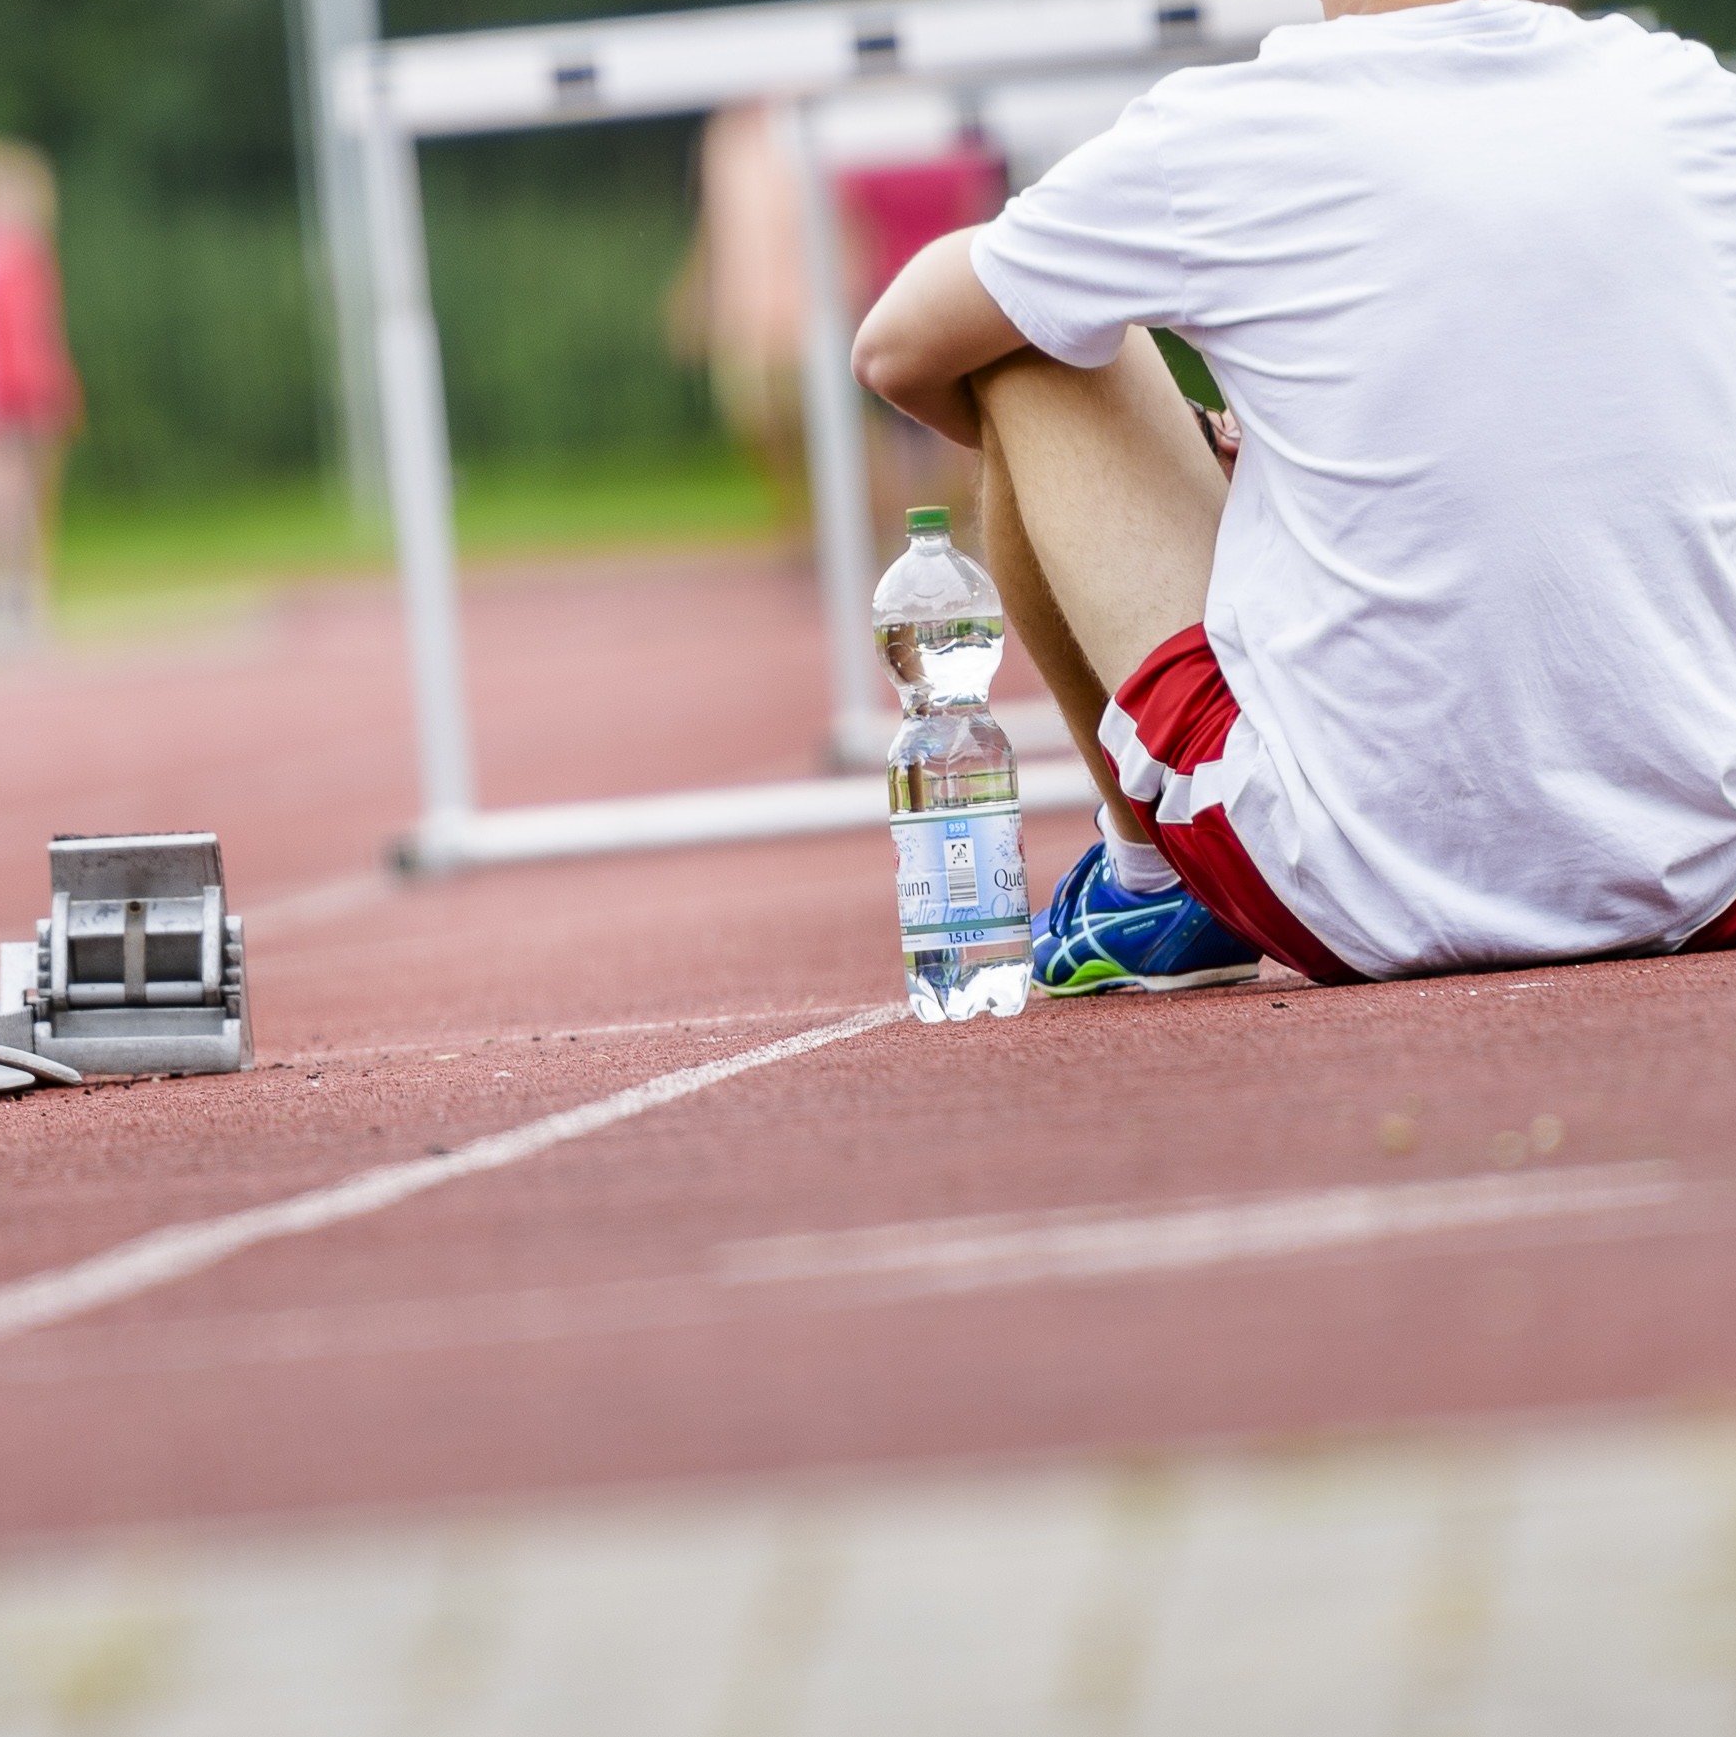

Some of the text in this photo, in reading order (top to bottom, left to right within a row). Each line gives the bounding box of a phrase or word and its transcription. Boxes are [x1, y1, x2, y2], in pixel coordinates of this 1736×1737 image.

[948, 822, 966, 833] 959
[948, 932, 962, 944] 1,5
[964, 931, 971, 942] L
